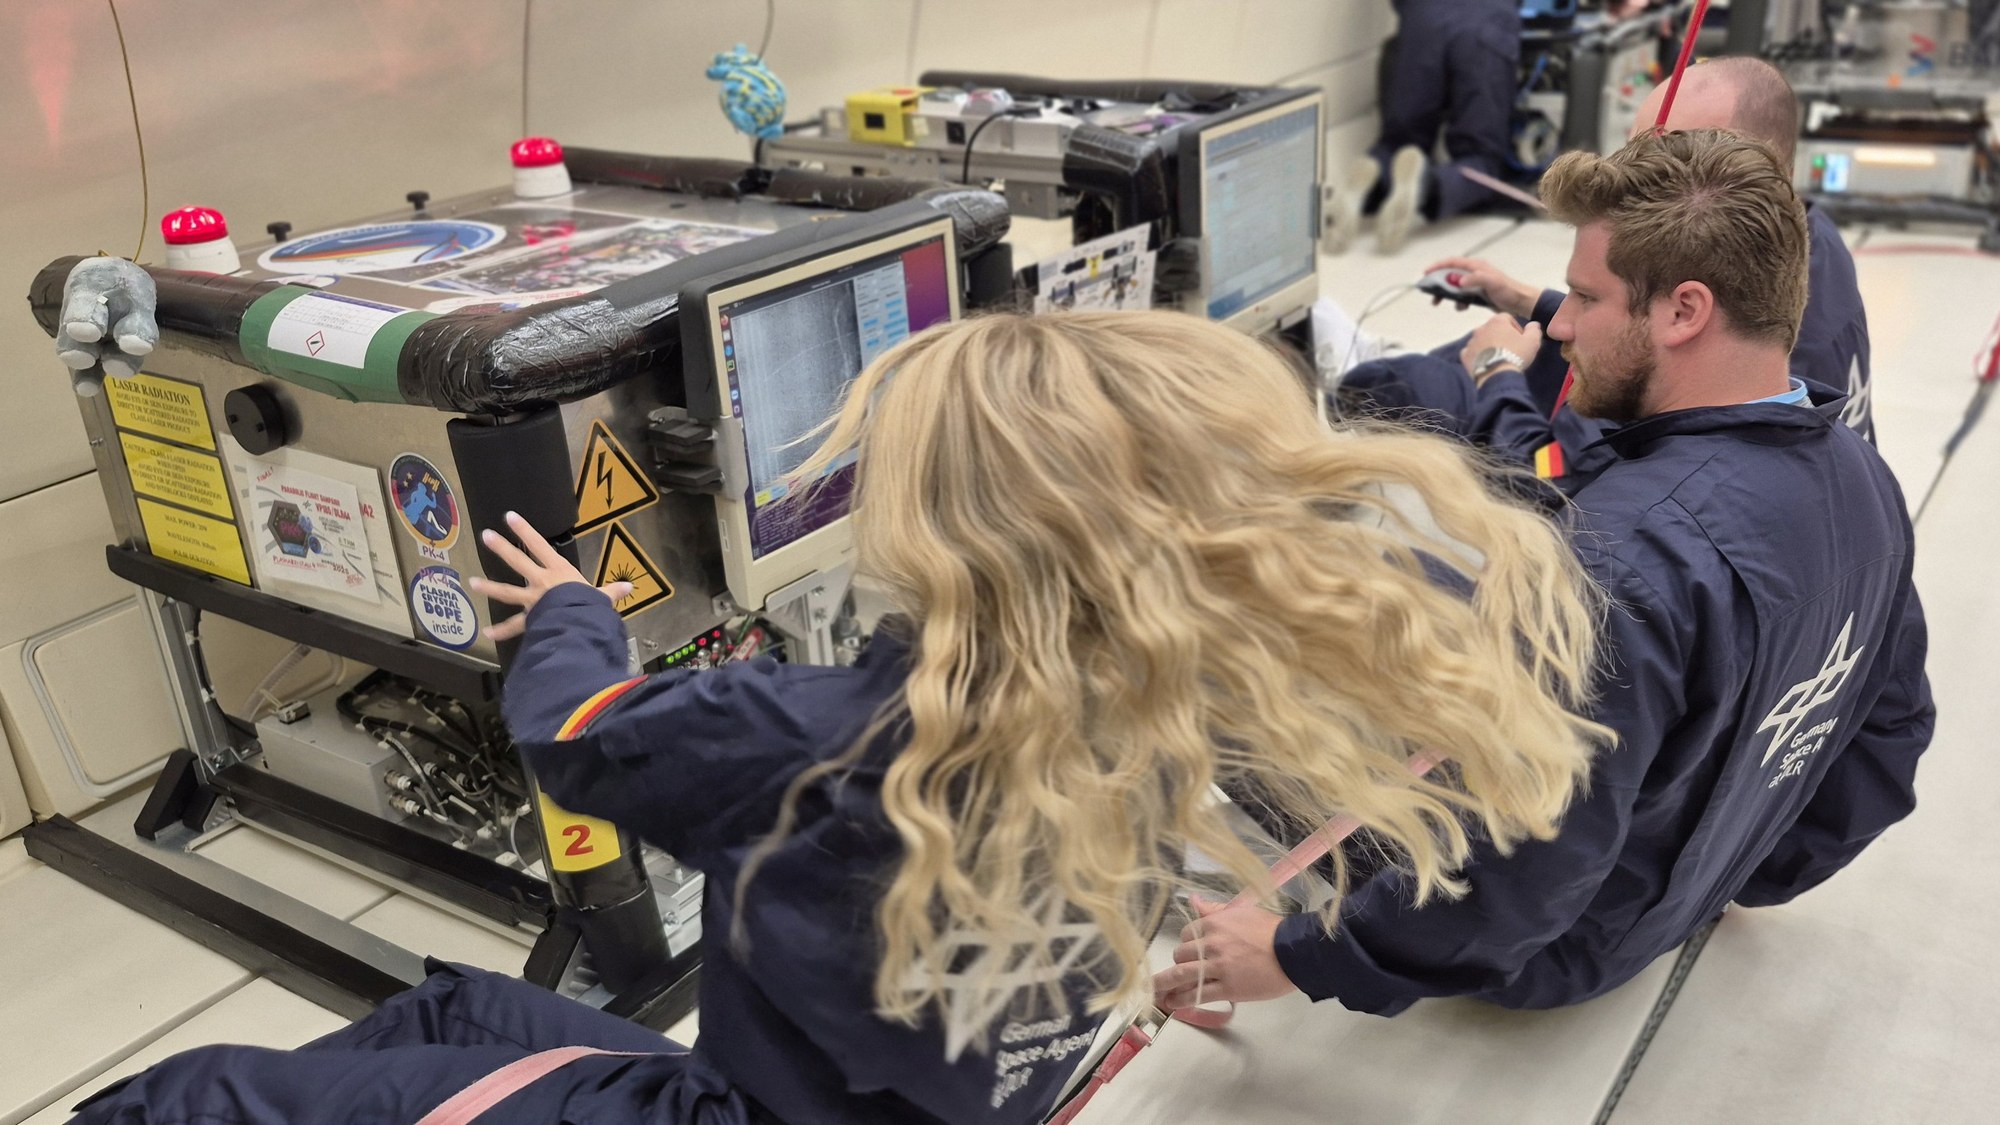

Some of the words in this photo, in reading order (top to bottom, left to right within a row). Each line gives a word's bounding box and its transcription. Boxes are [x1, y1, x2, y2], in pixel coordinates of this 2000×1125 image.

[112, 378, 140, 392] LASER
[141, 385, 190, 405] RADIATION
[422, 546, 445, 561] PK-4
[420, 584, 458, 602] PLASMA
[421, 592, 460, 610] CRYSTAL
[424, 600, 463, 624] DOPE
[432, 620, 464, 635] inside
[562, 824, 594, 856] 2
